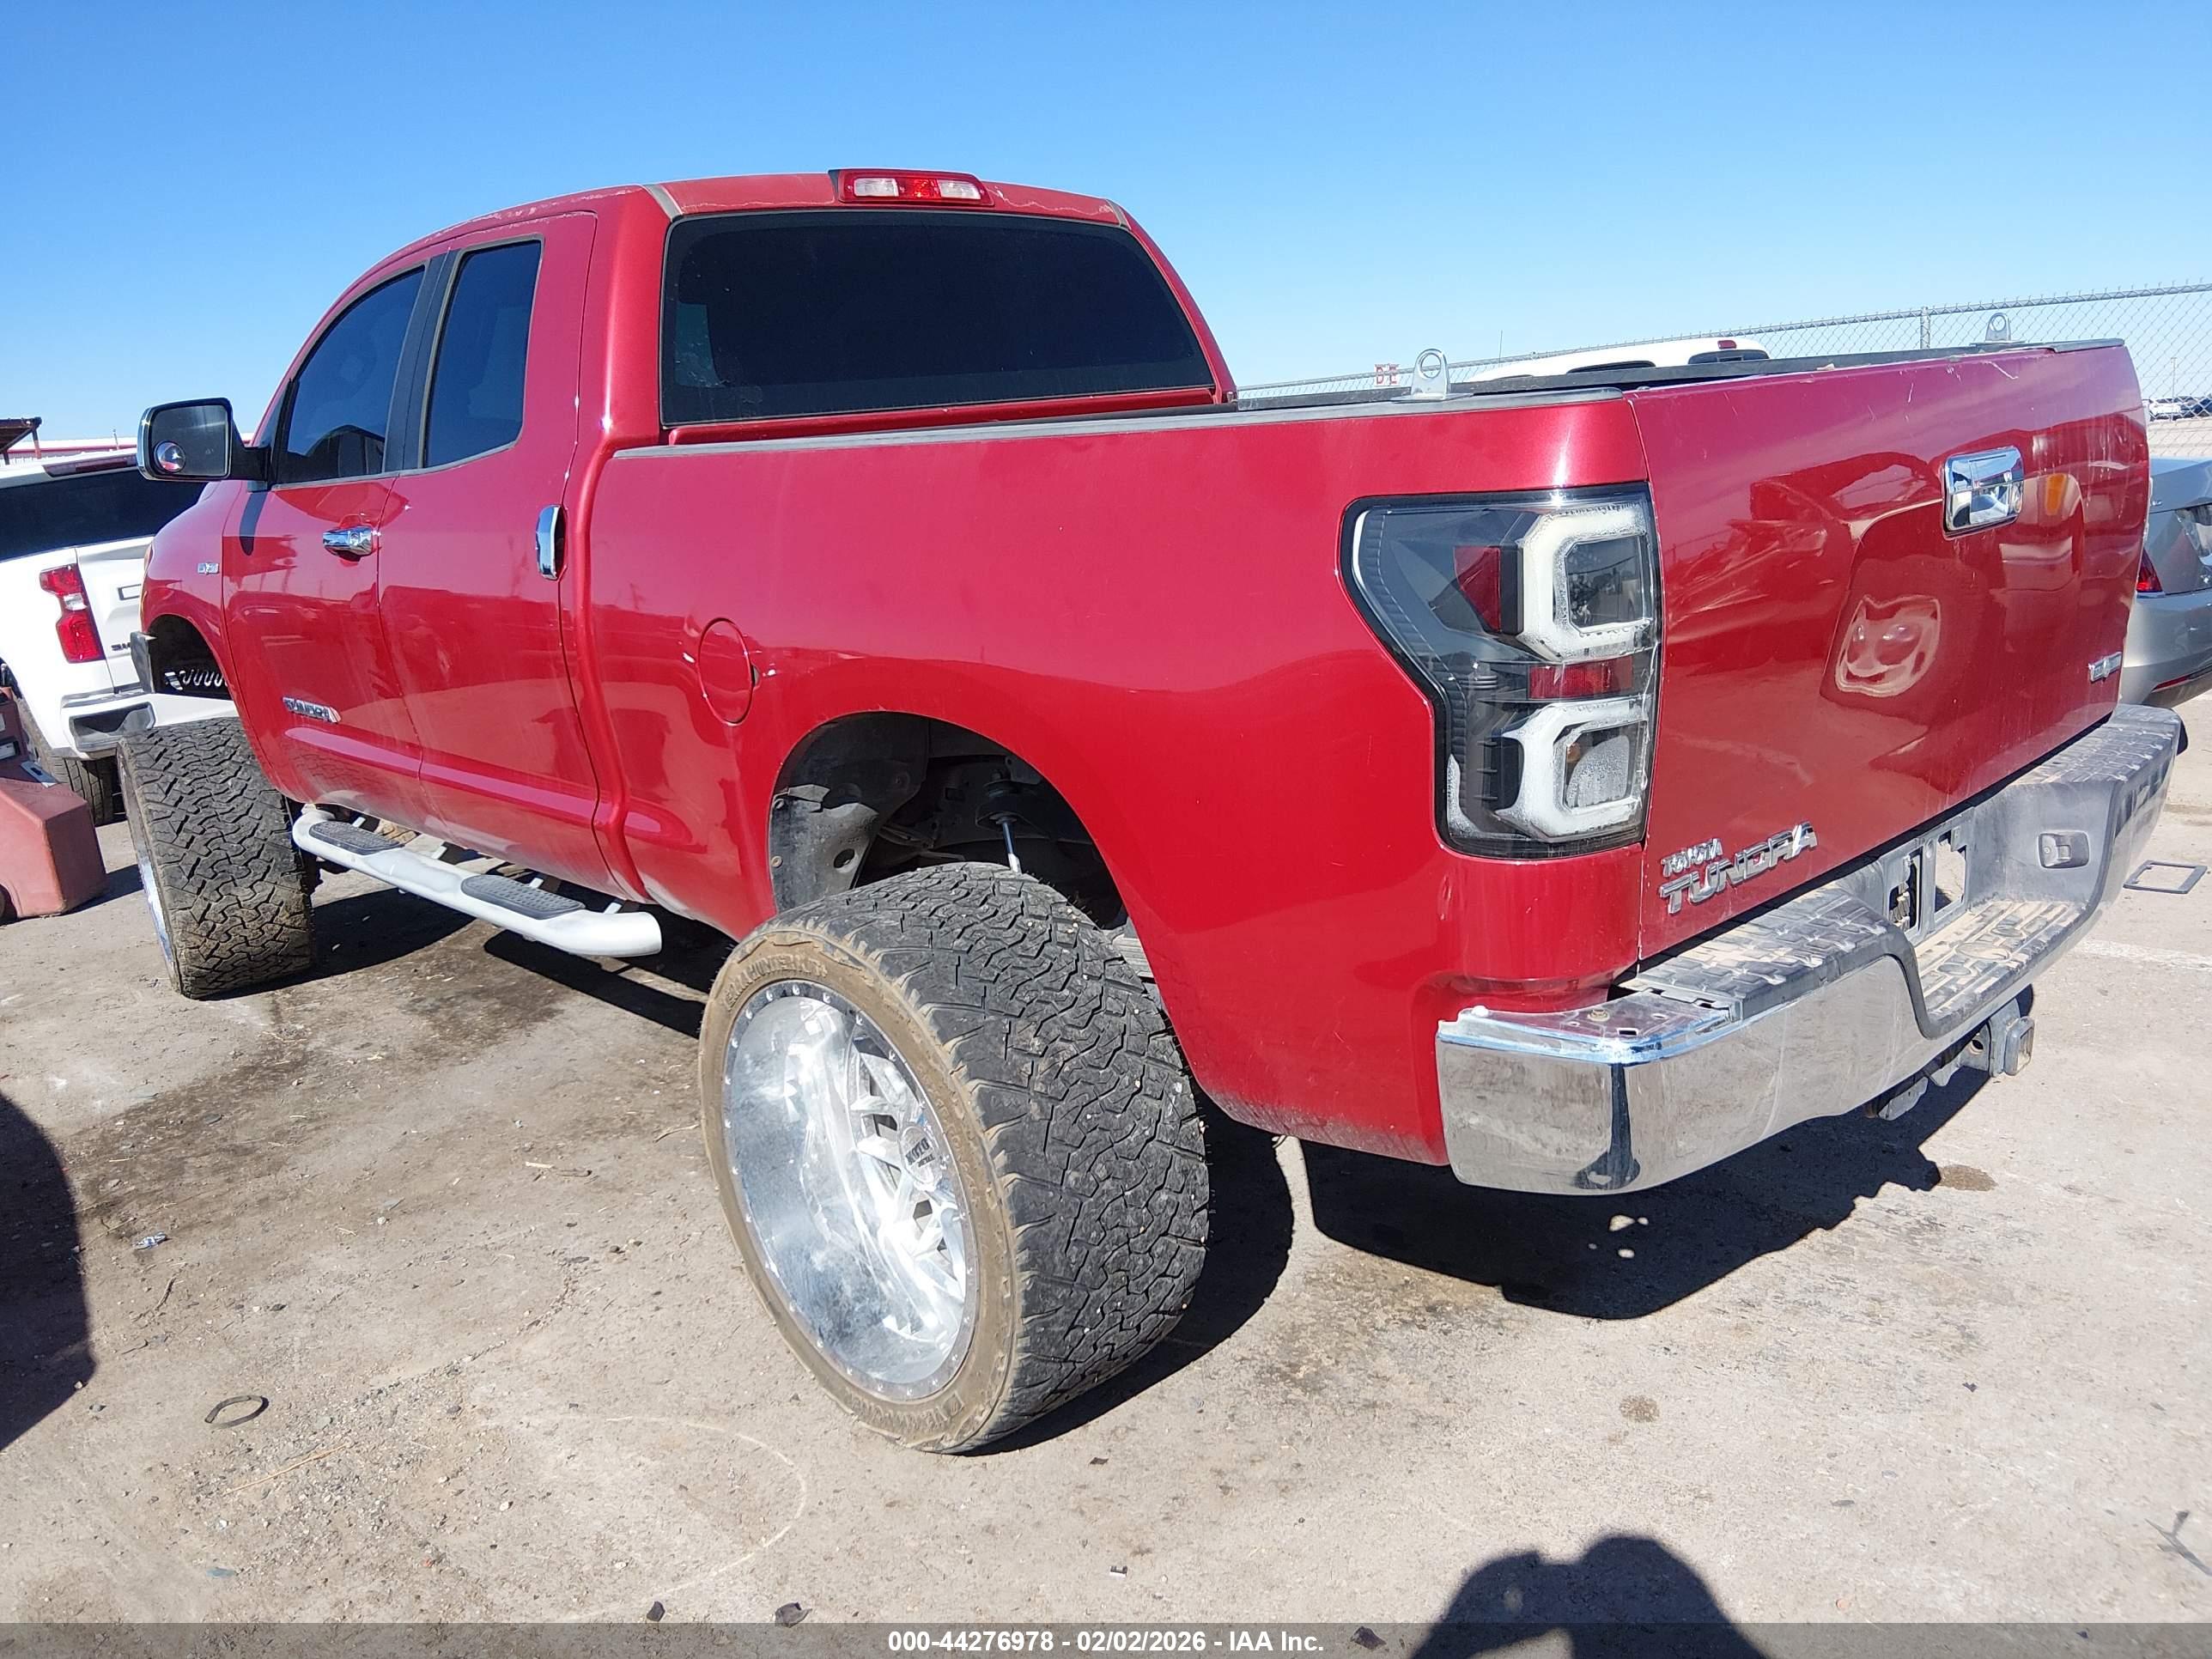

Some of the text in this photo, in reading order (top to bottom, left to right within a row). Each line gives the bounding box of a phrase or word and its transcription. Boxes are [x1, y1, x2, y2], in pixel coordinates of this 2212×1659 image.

[1660, 822, 1818, 914] TUNDRA
[1662, 837, 1723, 877] TOYOTA
[905, 1137, 930, 1165] MOTO
